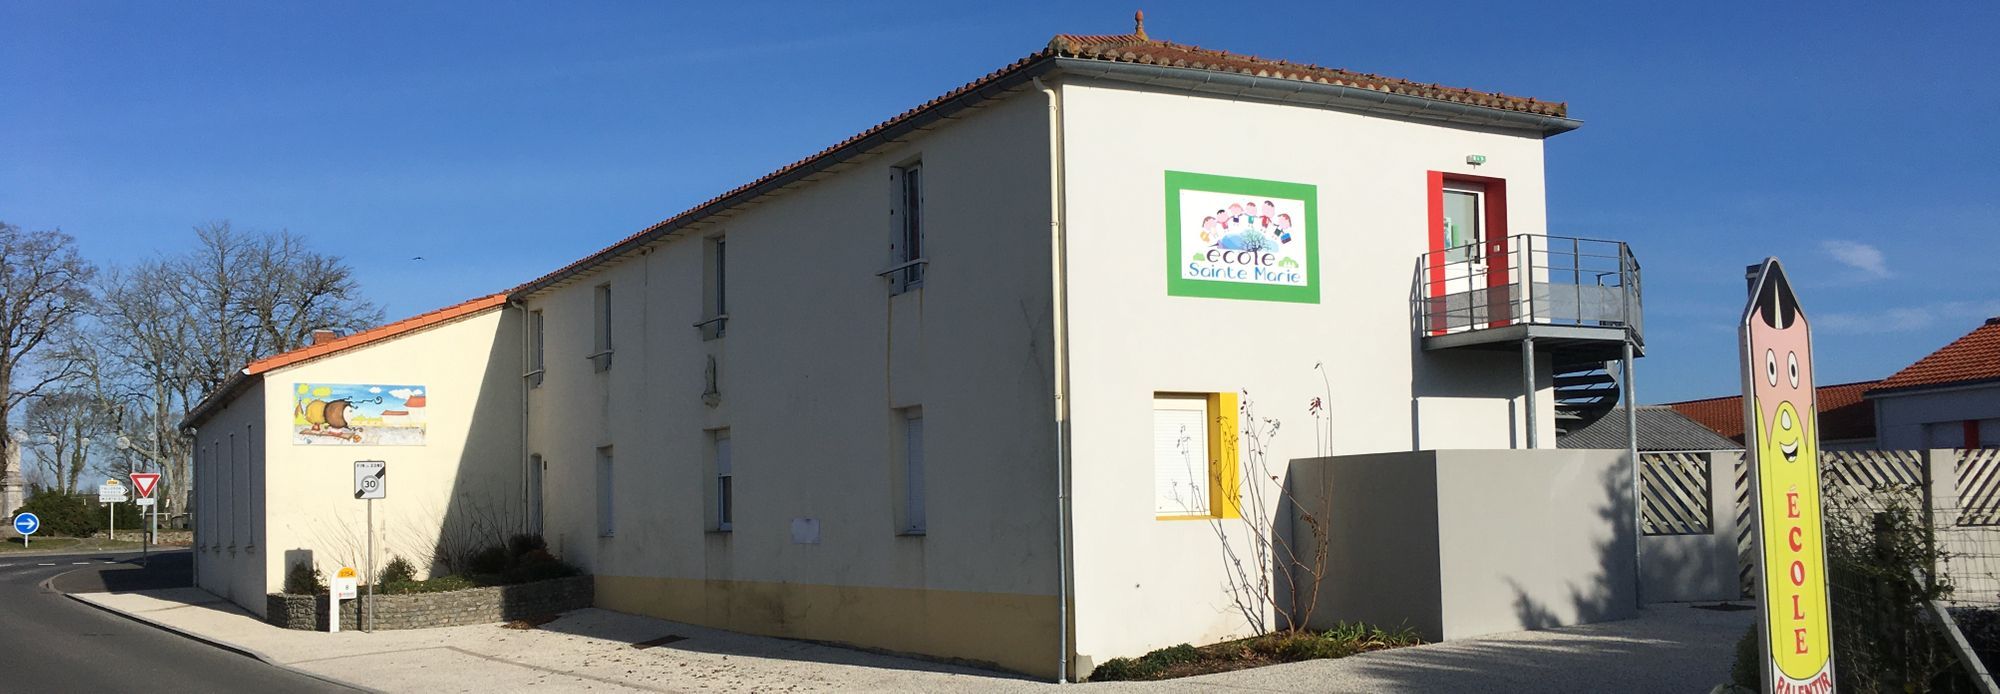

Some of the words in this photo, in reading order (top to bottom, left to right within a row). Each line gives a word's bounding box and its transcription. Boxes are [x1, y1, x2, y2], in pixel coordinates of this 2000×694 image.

[1189, 262, 1248, 280] Sainte
[1254, 266, 1301, 283] Marie
[364, 480, 376, 488] 30
[1786, 484, 1808, 654] ÉCOLE
